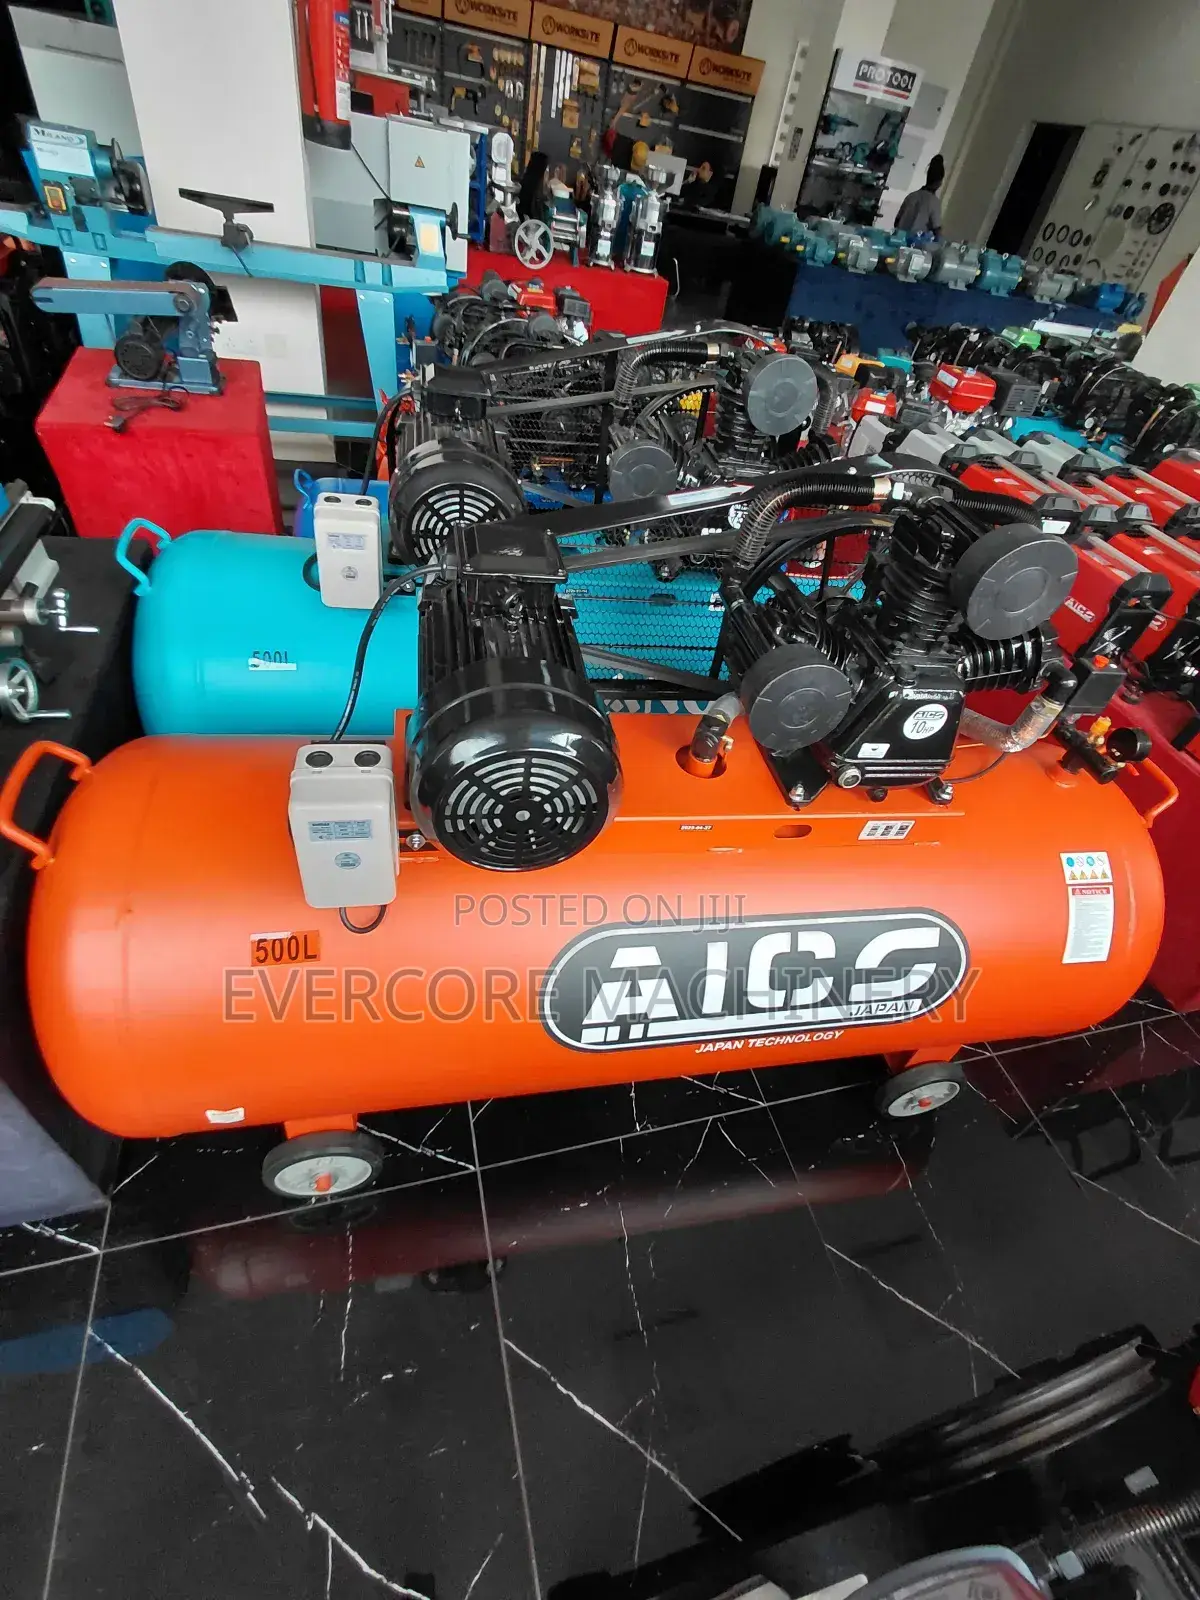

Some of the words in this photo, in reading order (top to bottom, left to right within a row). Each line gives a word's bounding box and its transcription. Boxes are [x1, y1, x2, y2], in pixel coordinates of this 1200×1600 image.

[859, 64, 913, 89] PROTOOL
[256, 935, 317, 963] 500L
[849, 1001, 914, 1016] JAPAN
[695, 1040, 744, 1053] JAPAN
[748, 1030, 844, 1048] TECHNOLOGY
